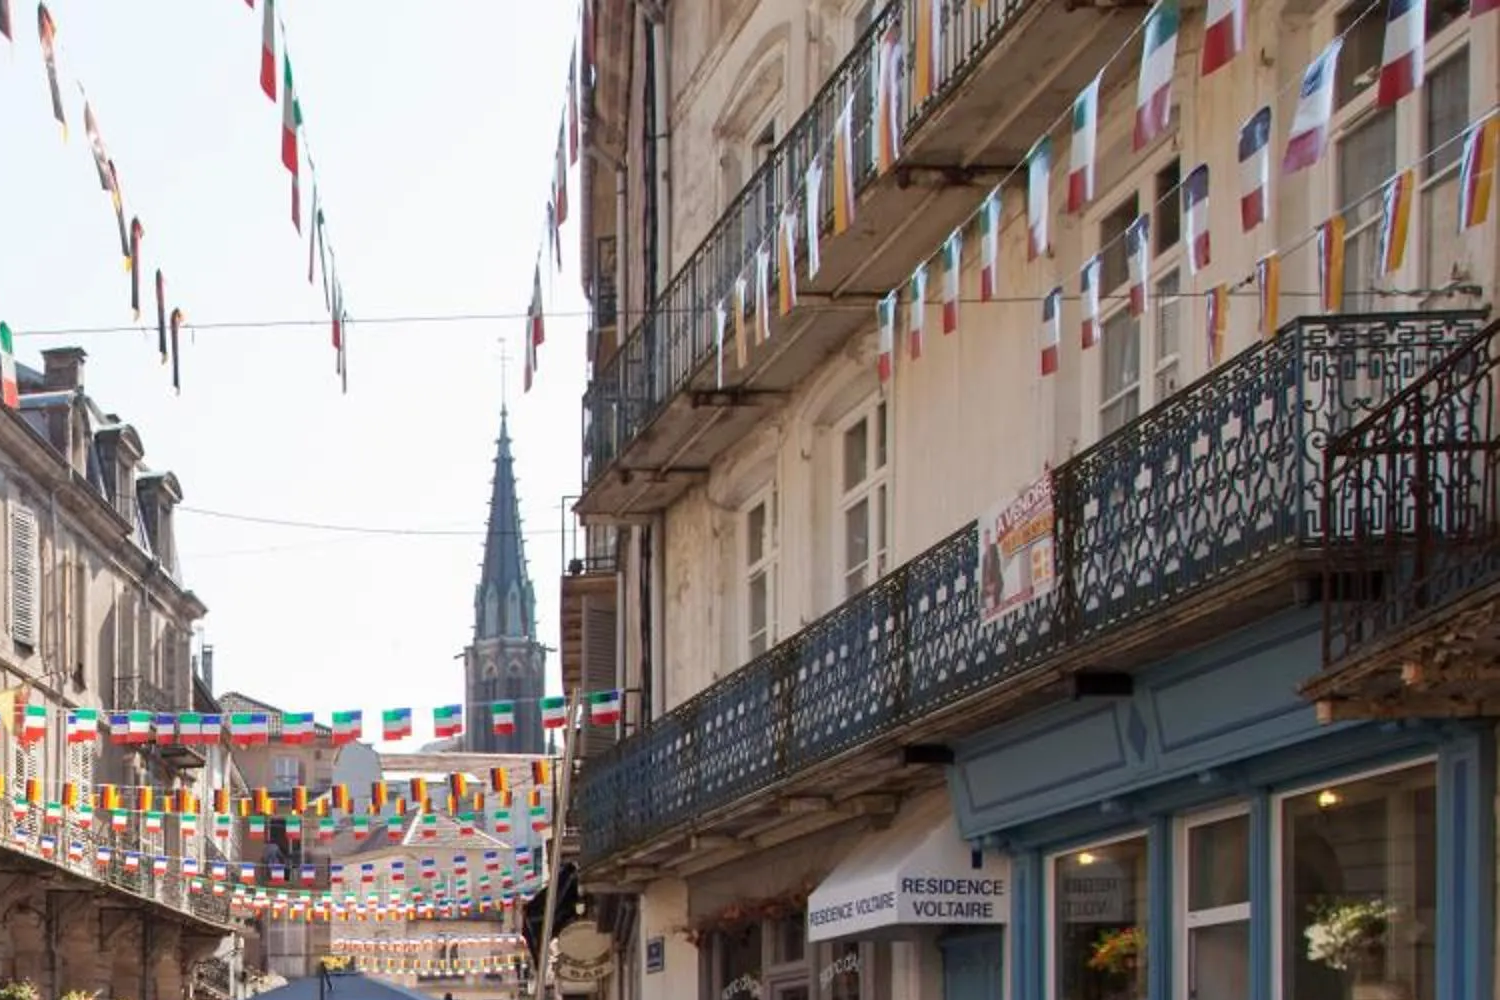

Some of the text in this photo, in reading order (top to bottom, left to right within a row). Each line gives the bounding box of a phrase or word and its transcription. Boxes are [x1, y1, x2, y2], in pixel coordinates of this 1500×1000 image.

[902, 878, 1004, 896] RESIDENCE
[809, 891, 895, 926] RESIDENCE VOLTAIRE
[912, 901, 993, 918] VOLTAIRE
